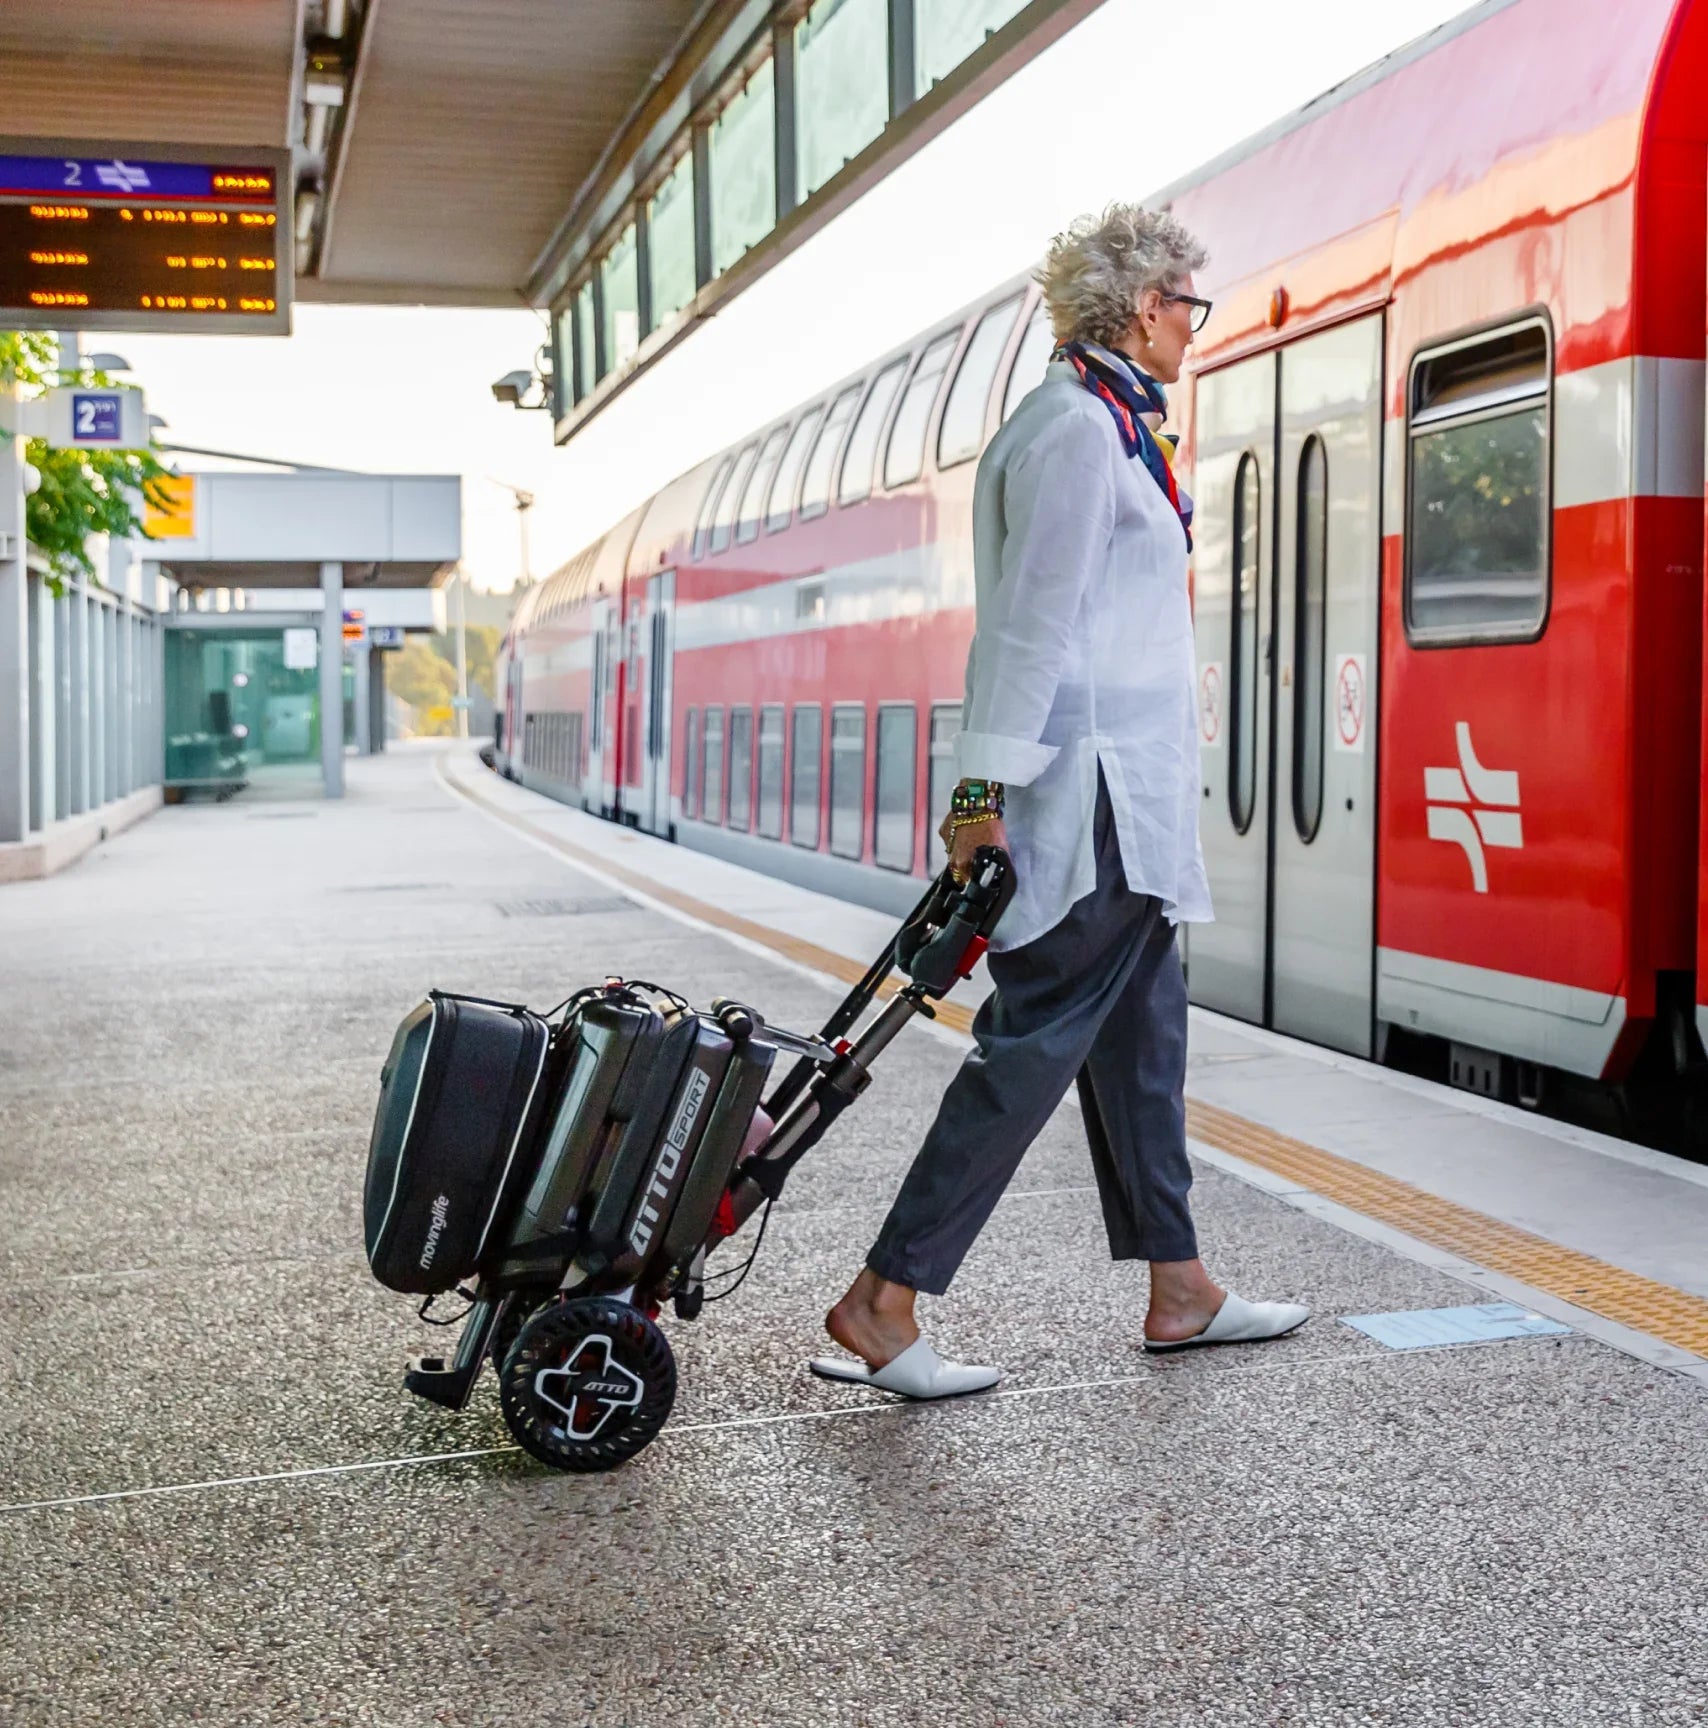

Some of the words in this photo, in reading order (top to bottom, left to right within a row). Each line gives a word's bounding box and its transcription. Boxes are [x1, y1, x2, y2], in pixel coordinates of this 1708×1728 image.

[63, 162, 82, 186] 2
[77, 400, 96, 433] 2
[629, 1143, 681, 1257] ATTO
[672, 1072, 708, 1149] SPORT
[420, 1194, 450, 1270] movinglife
[582, 1381, 630, 1394] ATTO
